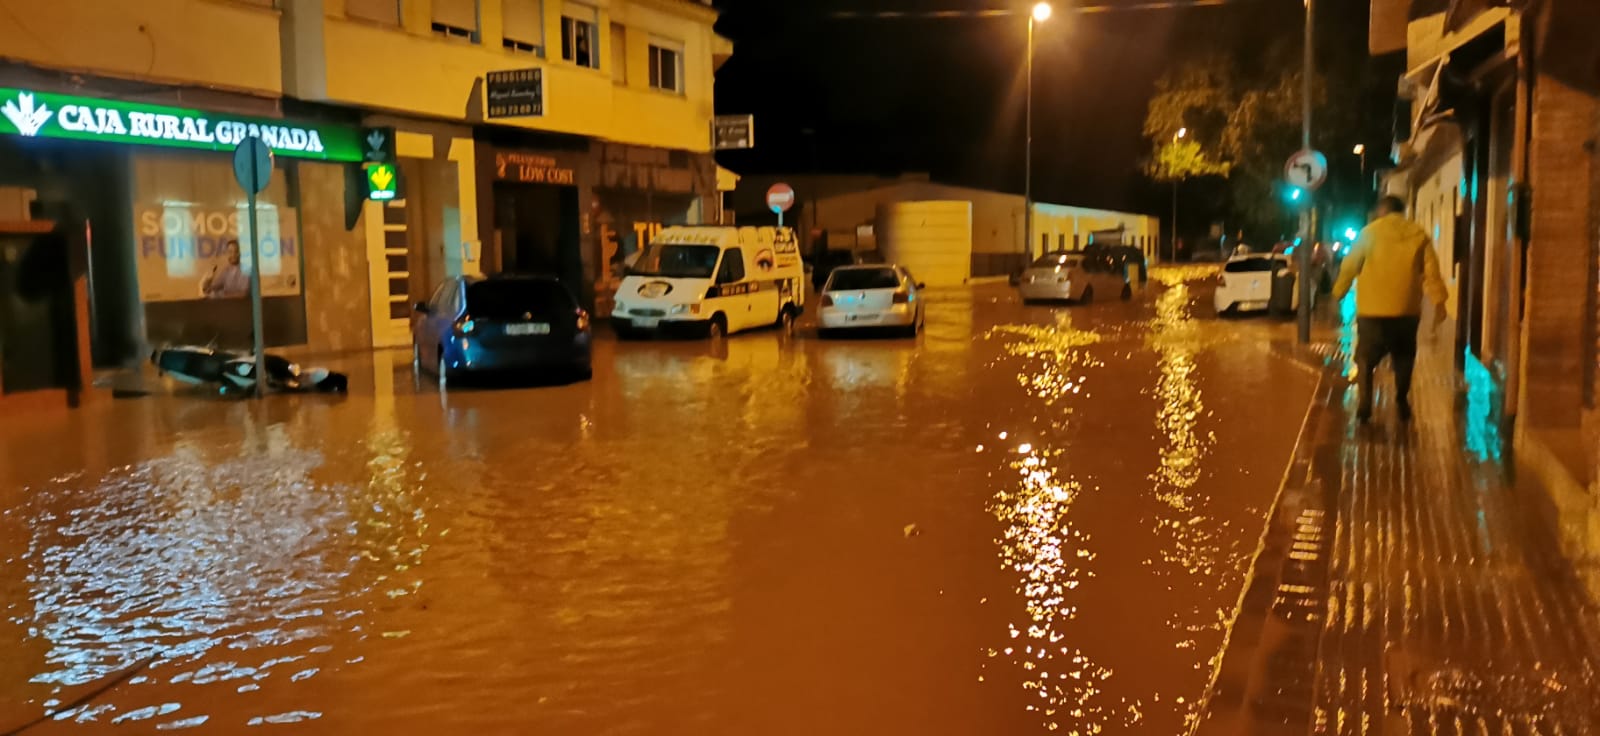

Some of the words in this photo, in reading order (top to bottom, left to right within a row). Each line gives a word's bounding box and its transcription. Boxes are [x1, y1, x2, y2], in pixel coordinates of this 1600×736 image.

[57, 104, 127, 135] CAJA
[128, 111, 215, 144] RURAL
[215, 120, 324, 152] GRANADA
[519, 165, 545, 182] LOW
[546, 168, 573, 185] COST
[141, 209, 244, 236] SOMOS
